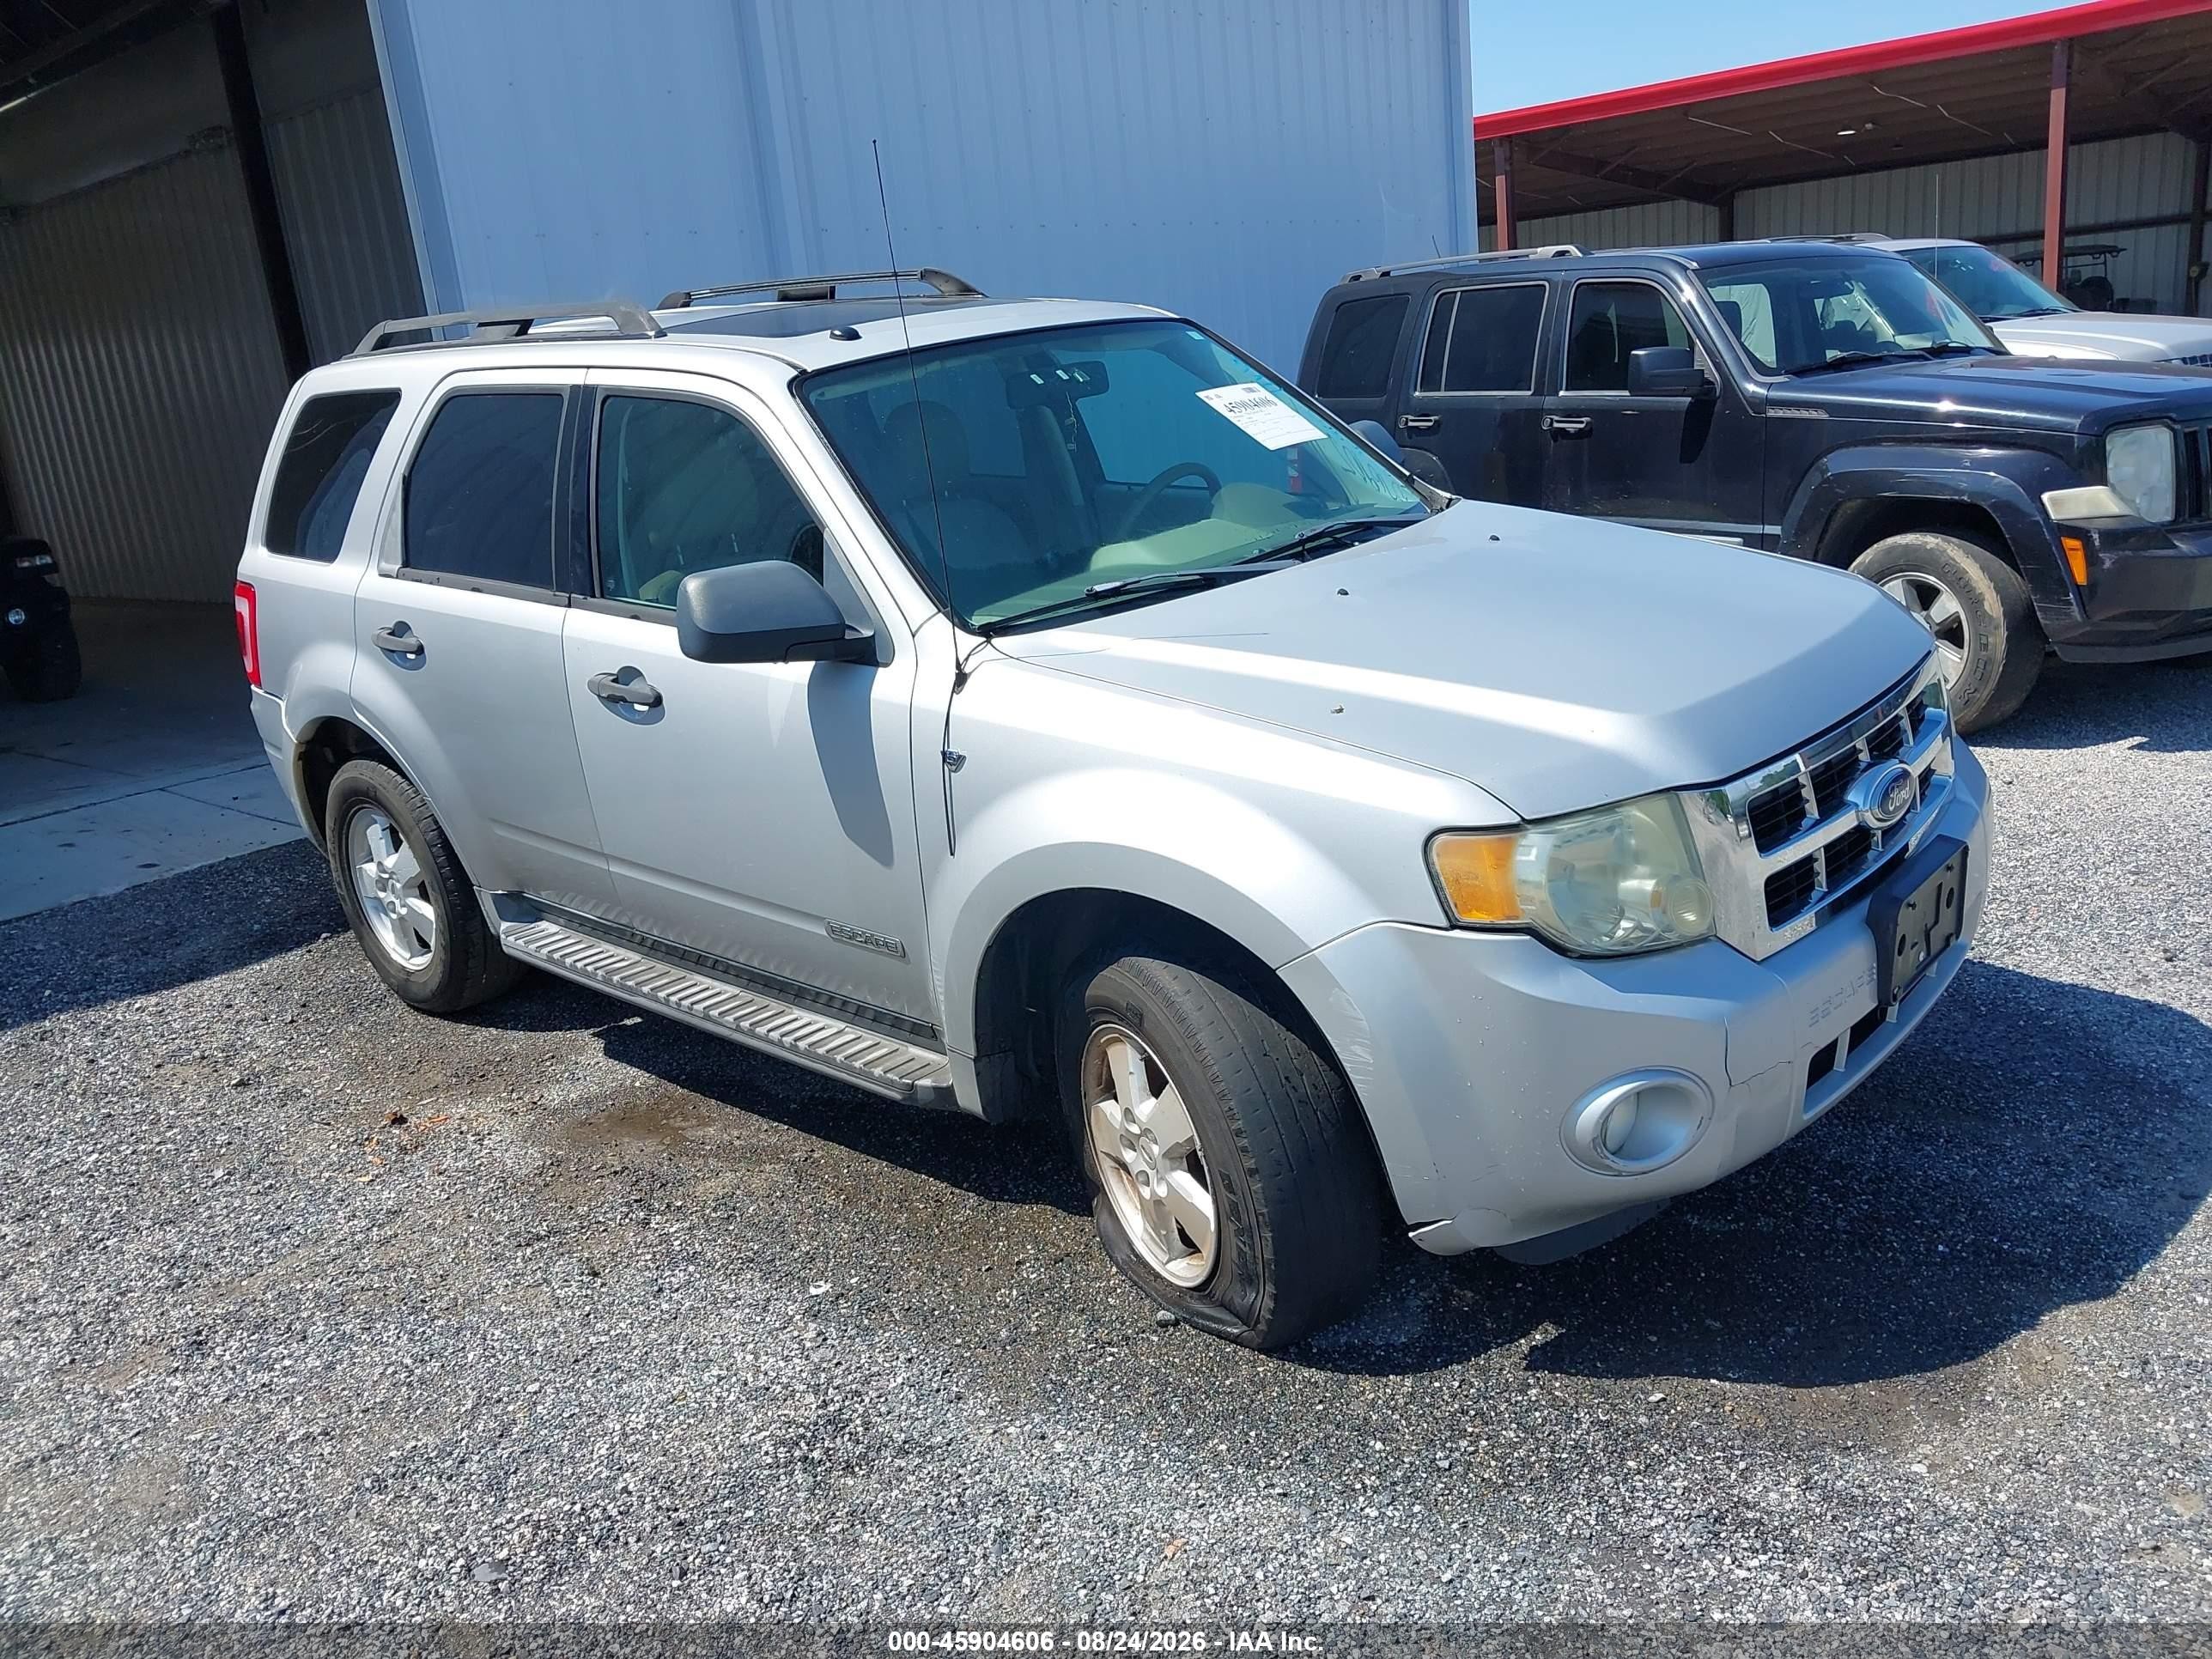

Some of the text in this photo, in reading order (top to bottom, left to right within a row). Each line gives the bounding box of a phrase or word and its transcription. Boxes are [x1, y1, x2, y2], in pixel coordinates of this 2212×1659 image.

[1223, 395, 1279, 415] 45904606
[1888, 779, 1911, 811] Ford
[830, 922, 899, 954] ESCAPE
